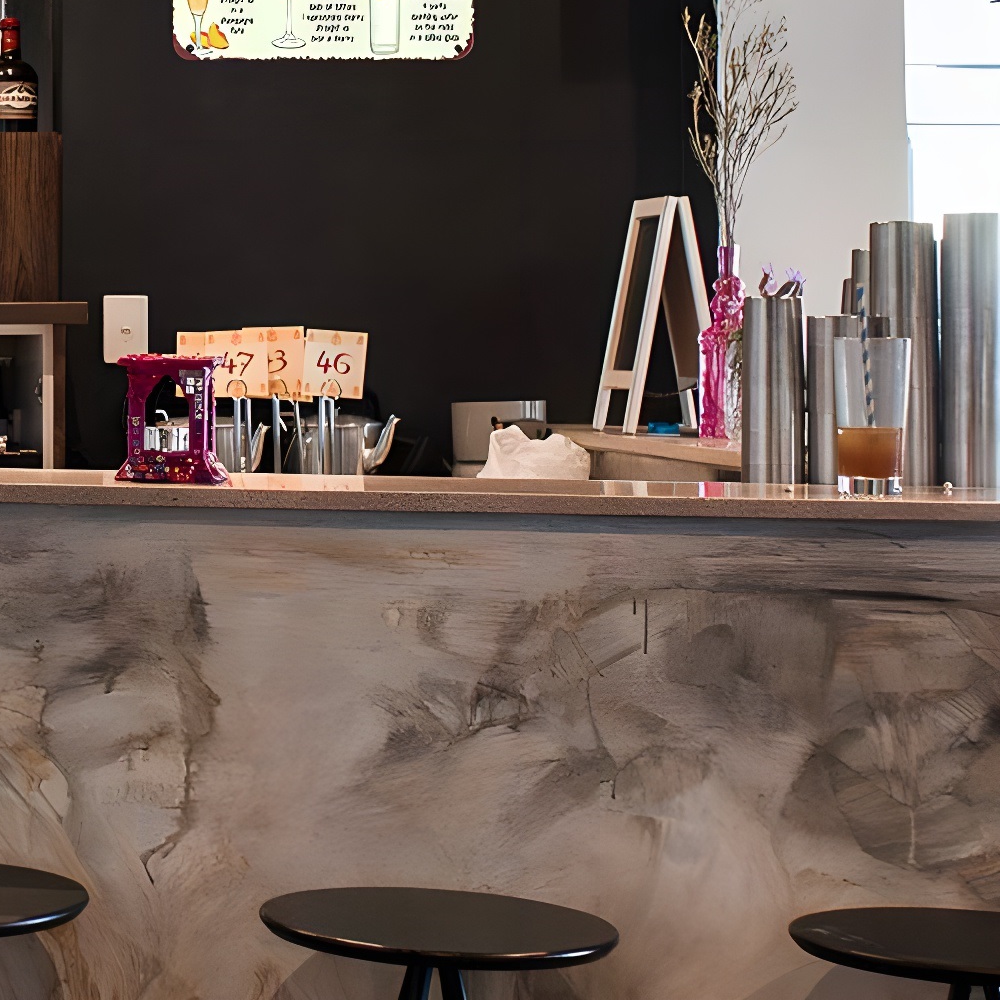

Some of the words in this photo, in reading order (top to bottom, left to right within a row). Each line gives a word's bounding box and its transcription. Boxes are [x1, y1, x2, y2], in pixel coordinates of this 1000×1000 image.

[220, 351, 255, 377] 47
[267, 349, 288, 375] 3
[316, 350, 353, 376] 46
